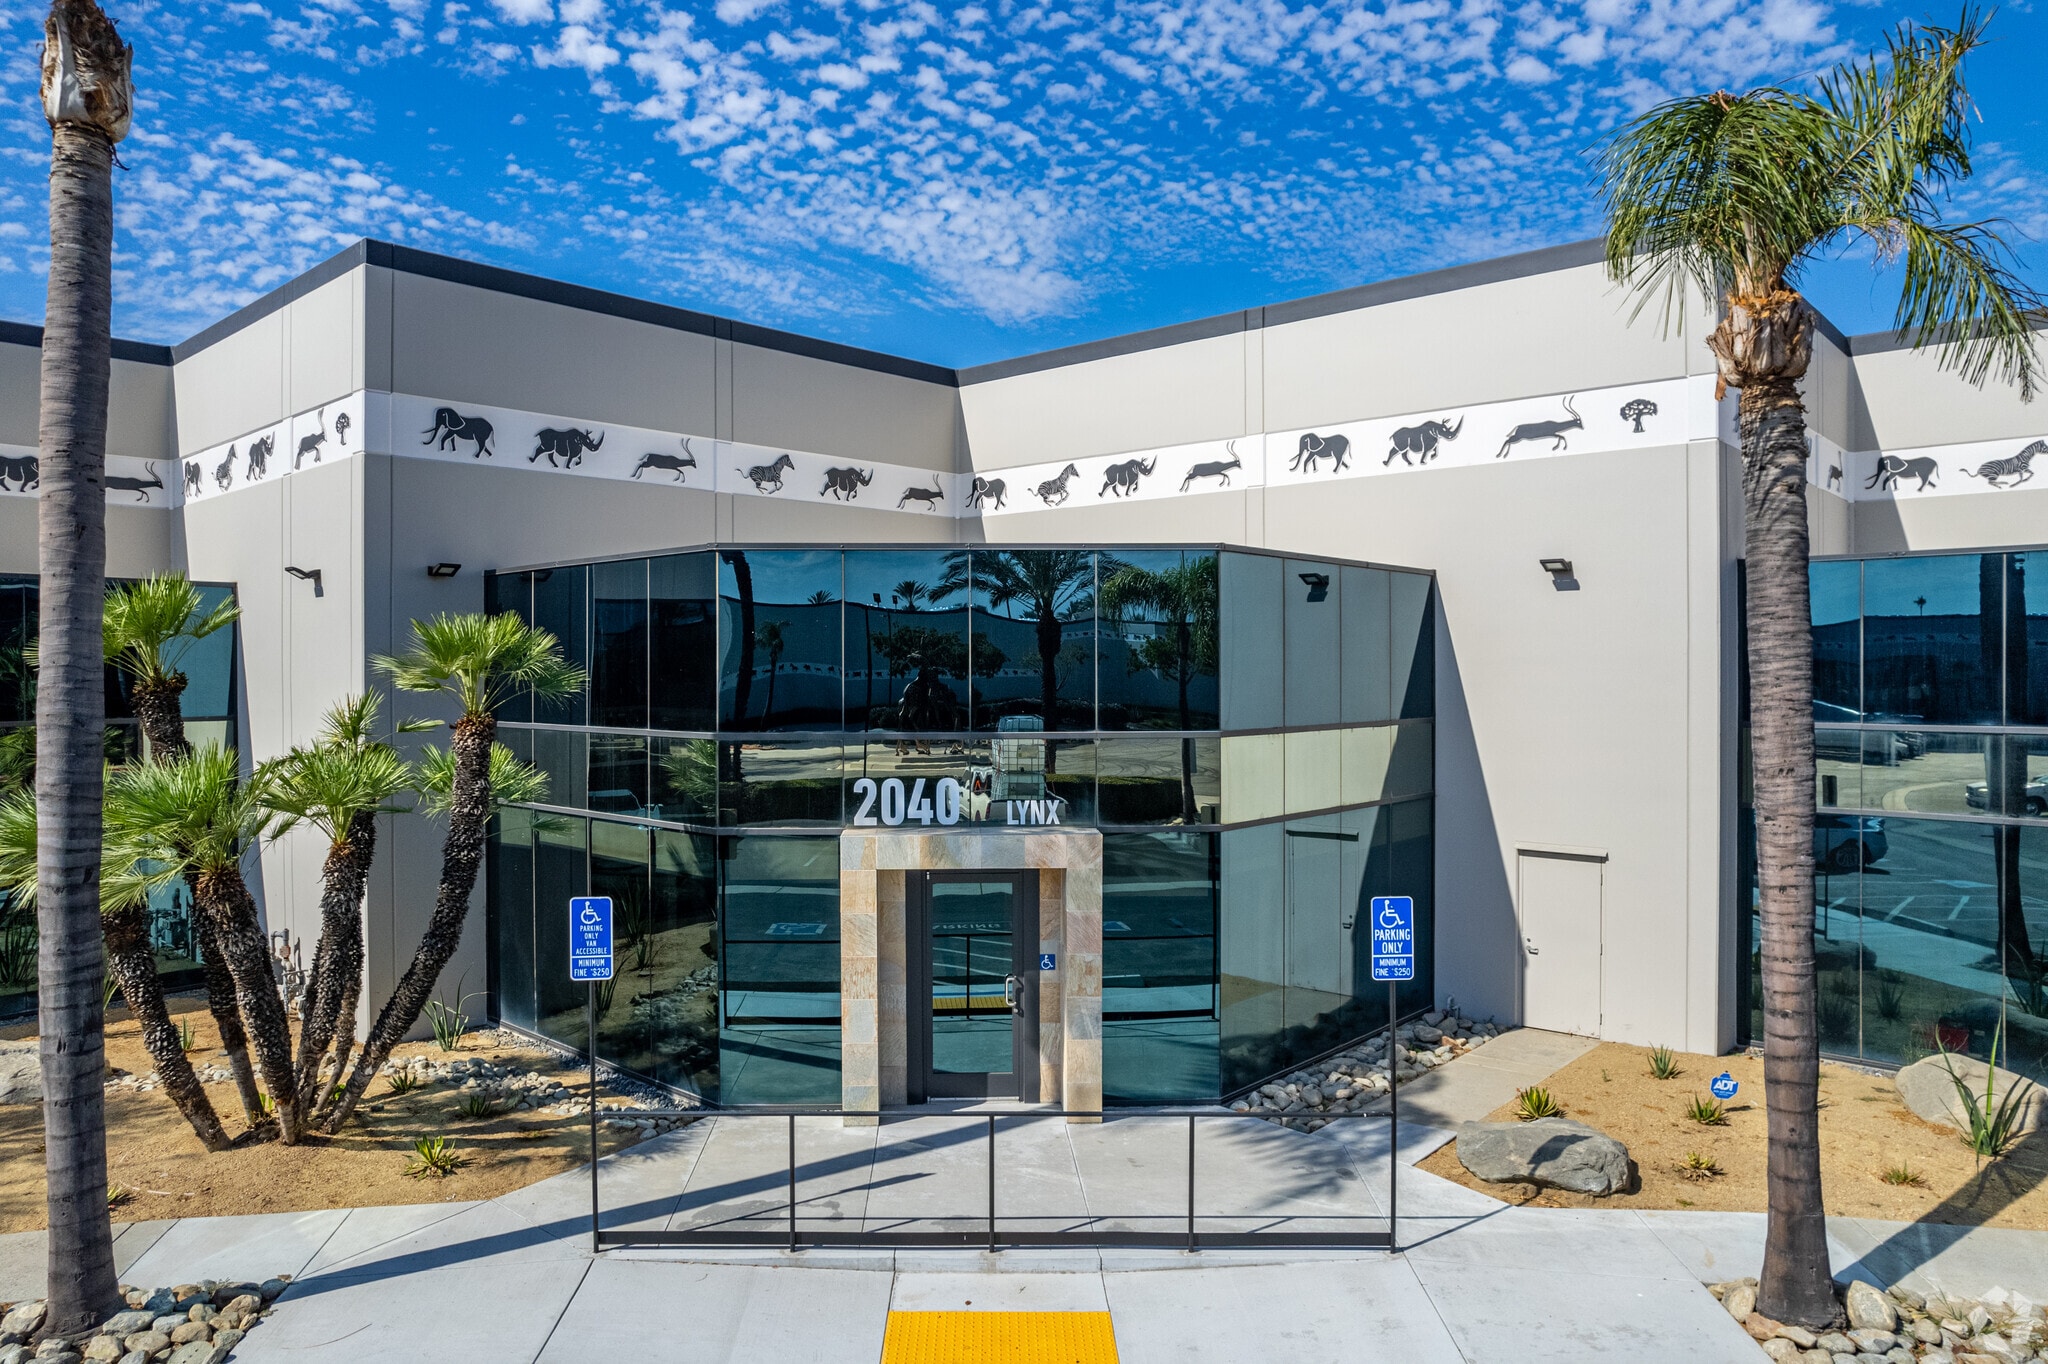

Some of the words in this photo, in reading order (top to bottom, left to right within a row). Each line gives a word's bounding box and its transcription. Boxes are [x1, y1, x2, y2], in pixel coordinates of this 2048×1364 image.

[853, 777, 960, 826] 2040
[1006, 800, 1061, 825] LYNX
[1375, 929, 1410, 941] PARKING
[1382, 942, 1403, 953] ONLY
[579, 959, 605, 967] MINIMUM
[1380, 959, 1406, 967] MINIMUM
[574, 968, 588, 977] FINE
[592, 967, 610, 977] $250
[1375, 968, 1389, 977] FINE
[1393, 967, 1411, 977] $250
[1713, 1080, 1736, 1091] ADT
